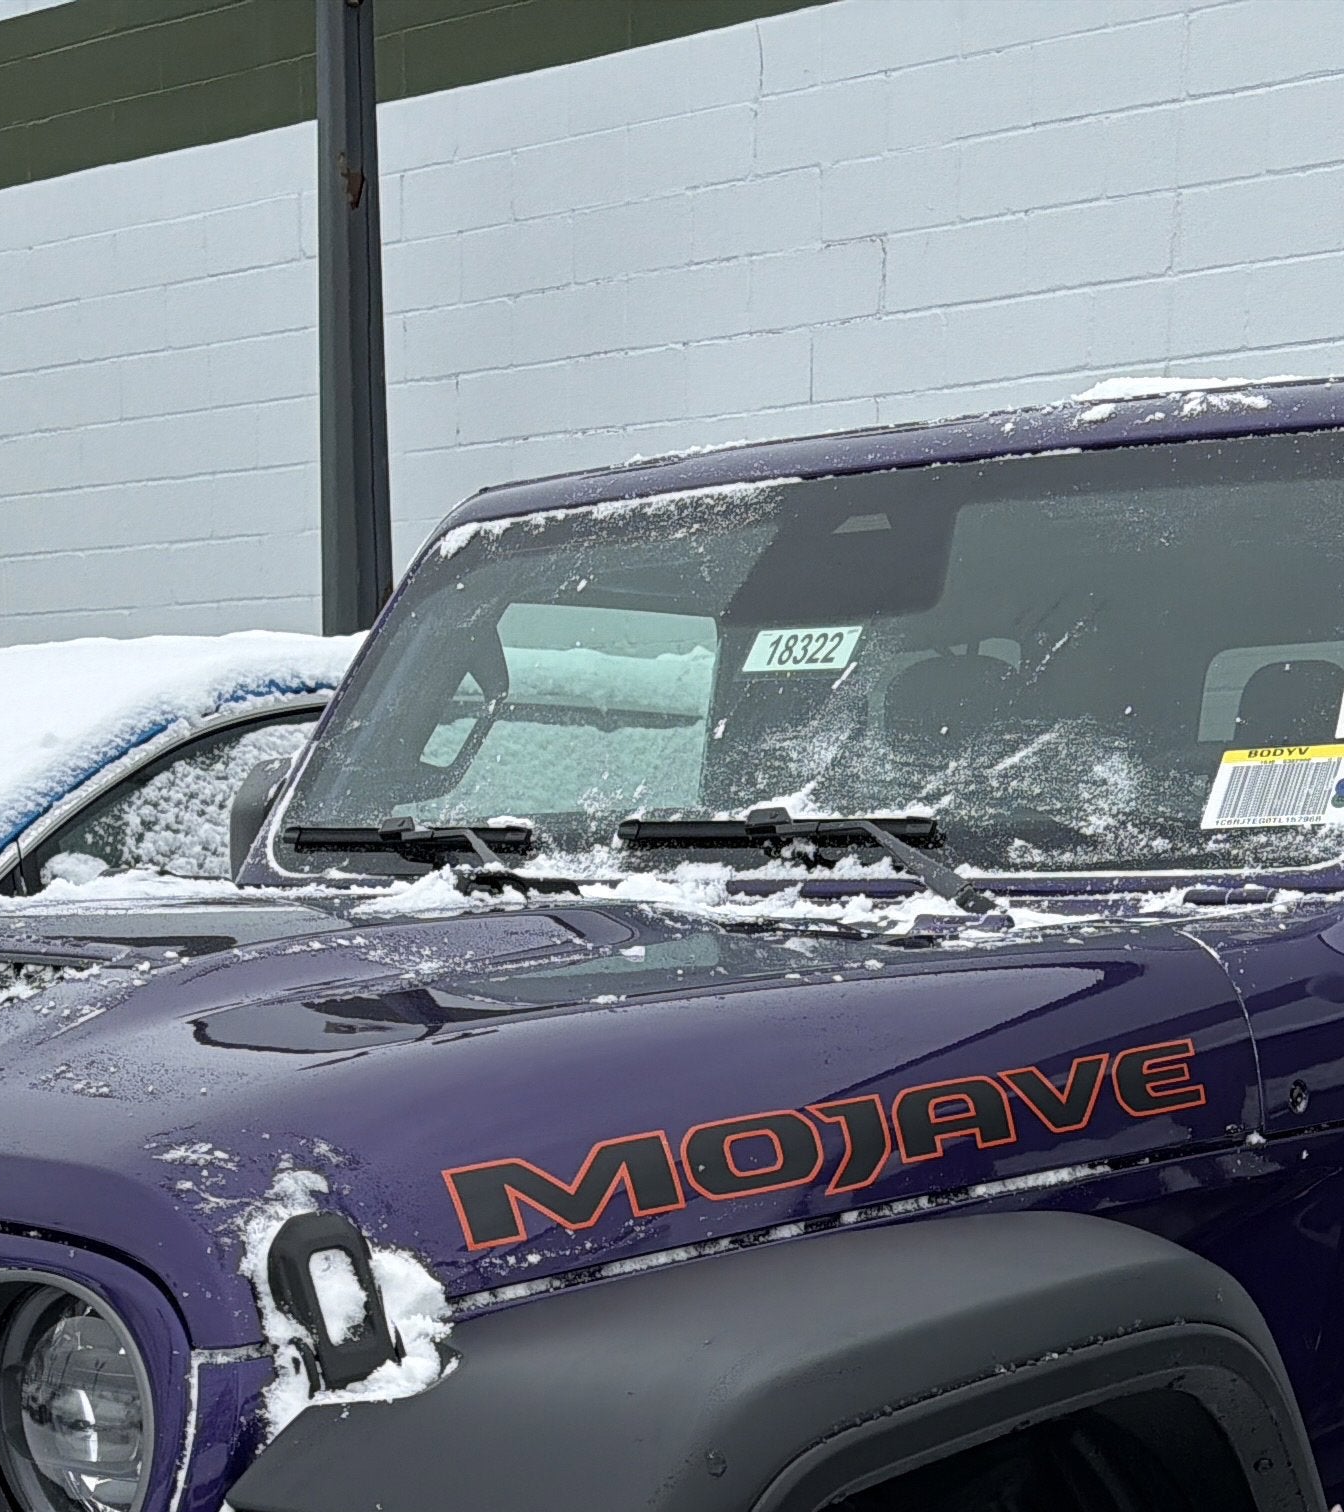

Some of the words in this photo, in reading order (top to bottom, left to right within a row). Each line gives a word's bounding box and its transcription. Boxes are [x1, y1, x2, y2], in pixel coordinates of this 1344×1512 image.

[766, 631, 844, 666] 18322
[1247, 746, 1310, 759] BODYV
[440, 1038, 1206, 1252] MOJAVE
